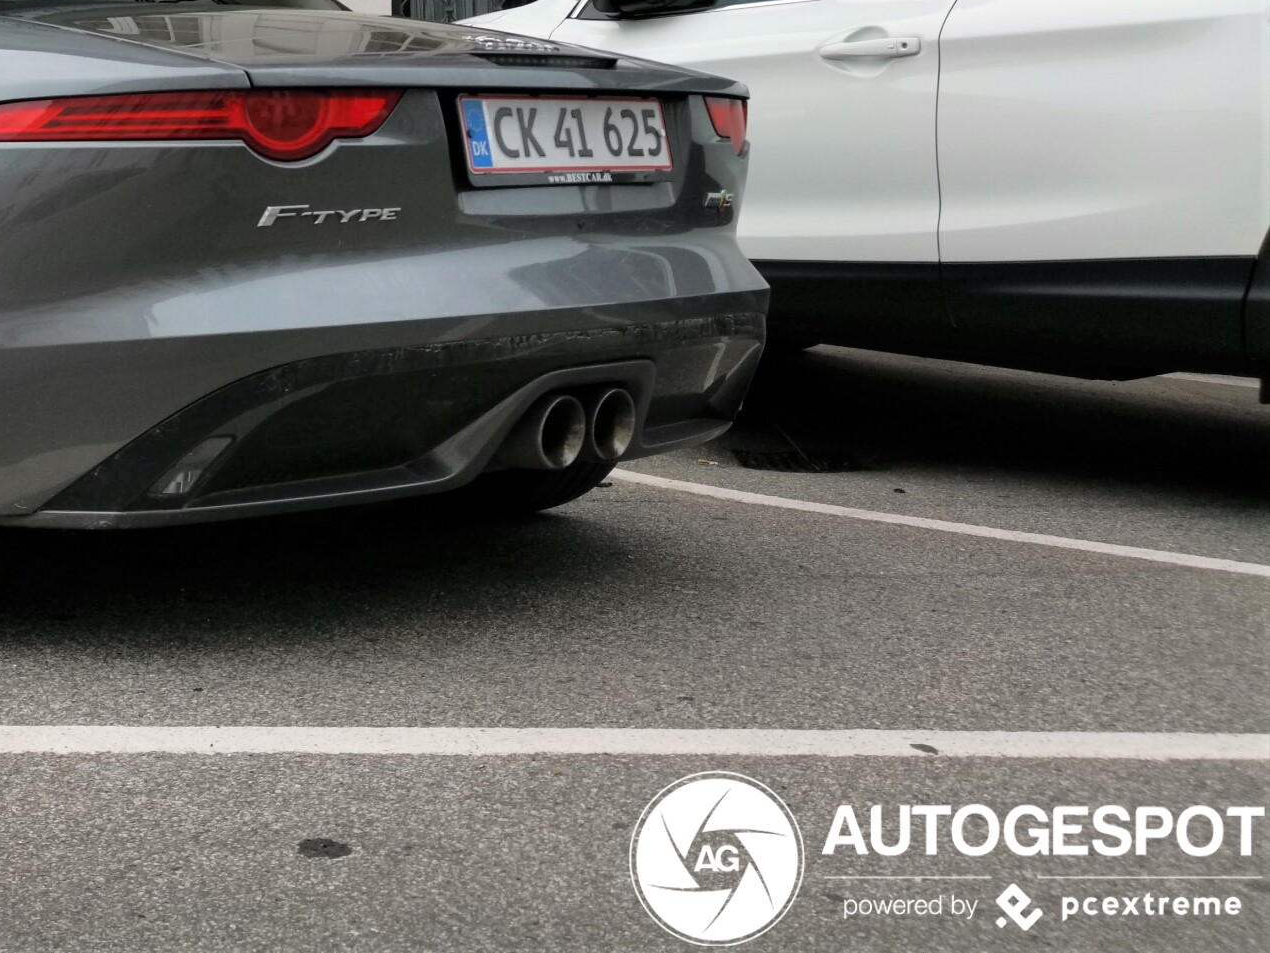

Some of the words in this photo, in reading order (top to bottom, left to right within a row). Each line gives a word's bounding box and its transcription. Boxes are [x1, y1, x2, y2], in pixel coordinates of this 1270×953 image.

[493, 106, 547, 159] CK
[553, 107, 594, 158] 41
[602, 106, 664, 158] 625
[471, 140, 490, 157] DK
[548, 172, 613, 184] www.BESTCAR.dk
[257, 204, 402, 228] F-TYPE
